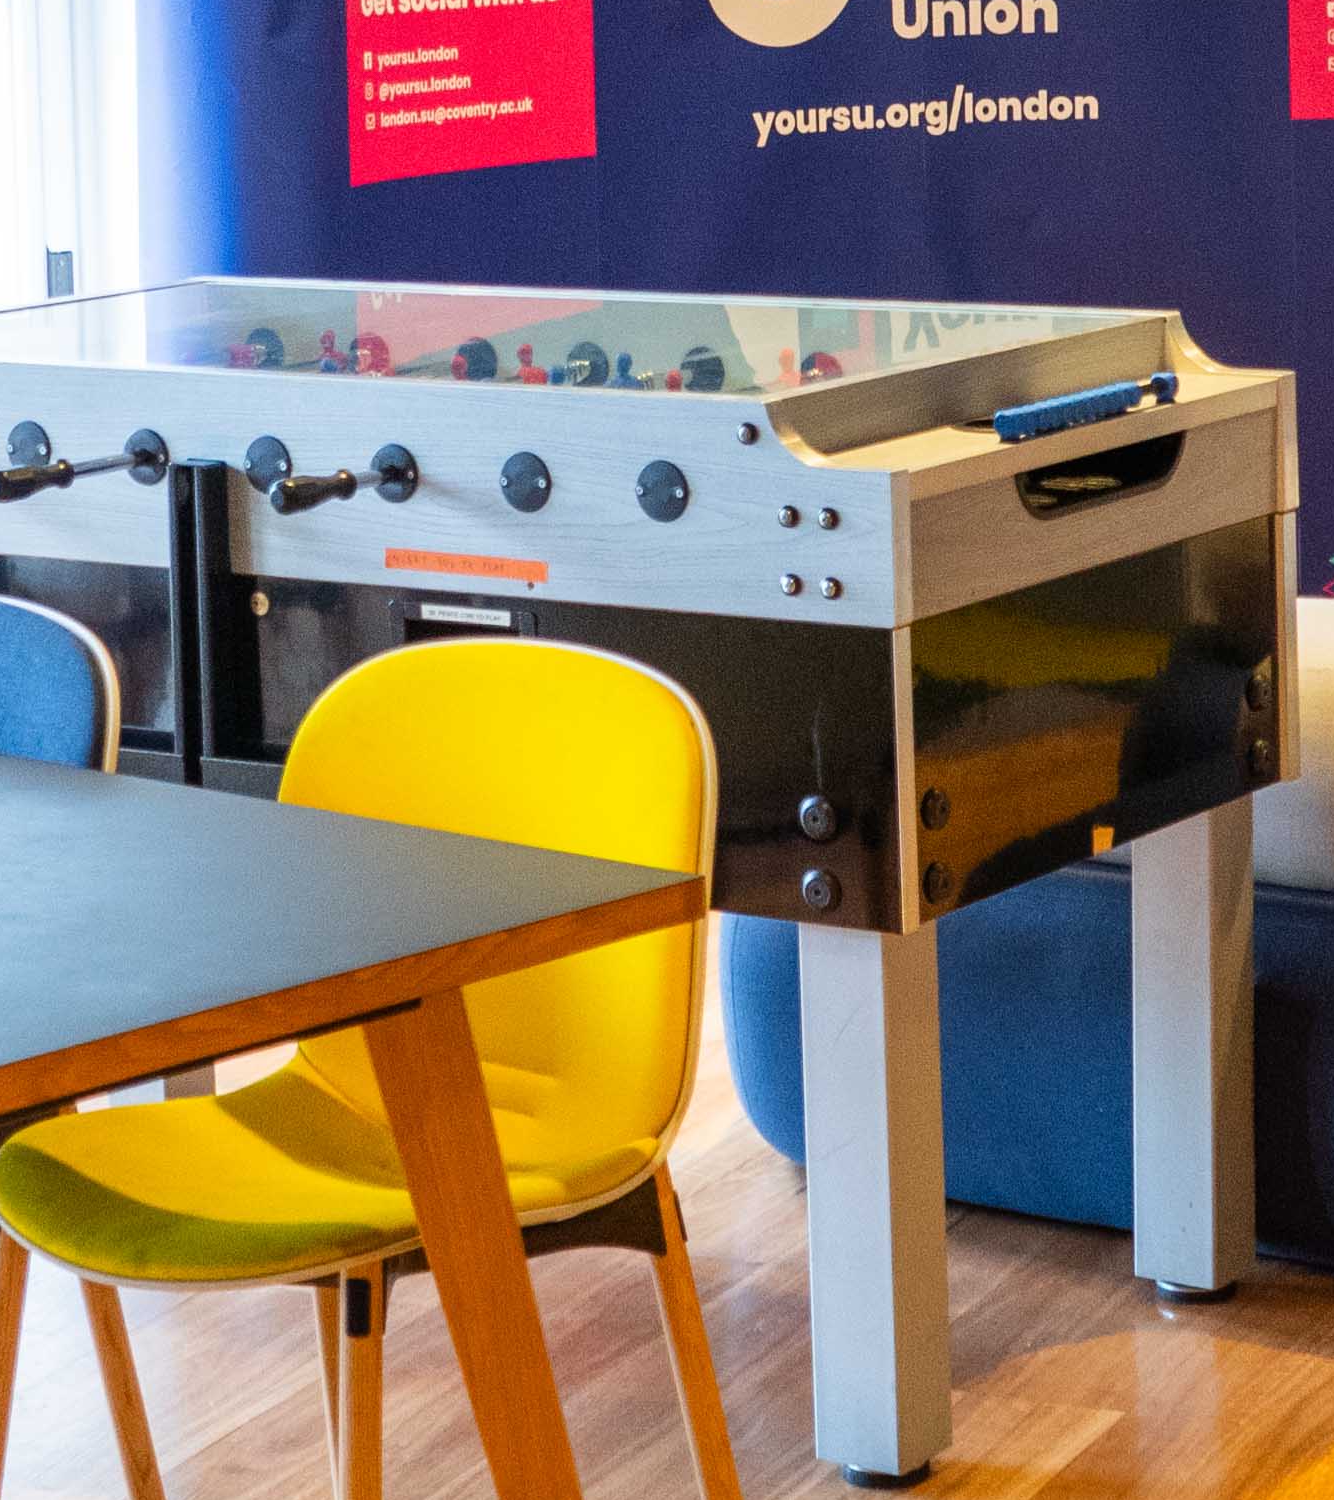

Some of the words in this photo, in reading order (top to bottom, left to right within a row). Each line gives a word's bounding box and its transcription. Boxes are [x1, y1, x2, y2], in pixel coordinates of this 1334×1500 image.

[377, 45, 459, 72] yoursu.london
[378, 74, 471, 102] @yoursu.london
[380, 96, 534, 128] london.su@coventry.ac.uk
[752, 84, 1100, 148] yoursu.org/london
